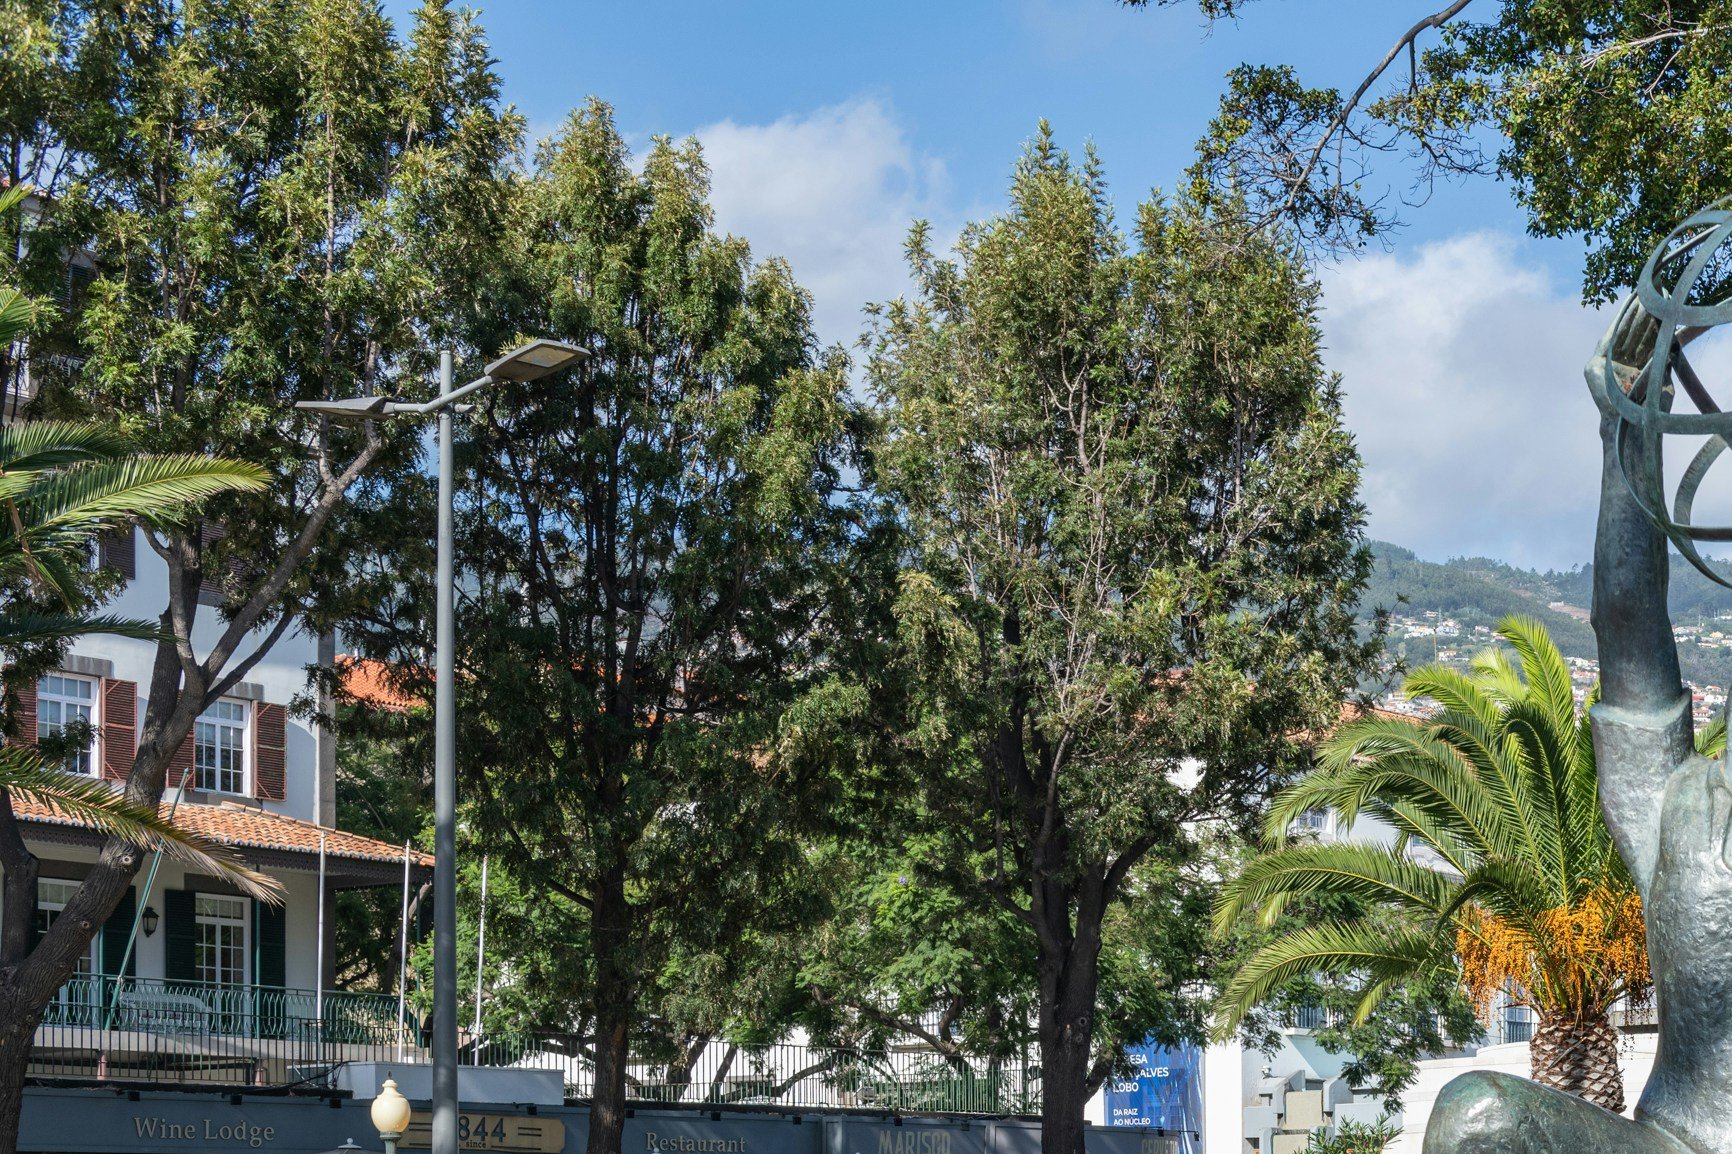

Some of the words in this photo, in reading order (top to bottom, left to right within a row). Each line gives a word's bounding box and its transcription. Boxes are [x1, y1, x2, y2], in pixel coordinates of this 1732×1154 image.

[1113, 1082, 1139, 1093] LOBO
[1113, 1108, 1123, 1116] DA
[1123, 1108, 1138, 1116] RAIZ
[1113, 1118, 1123, 1126] AO
[1124, 1116, 1151, 1126] NÚCLEO
[134, 1117, 196, 1139] Wine
[203, 1119, 275, 1148] Lodge
[458, 1115, 507, 1142] 844
[465, 1140, 487, 1149] since
[645, 1132, 746, 1153] Restaurant
